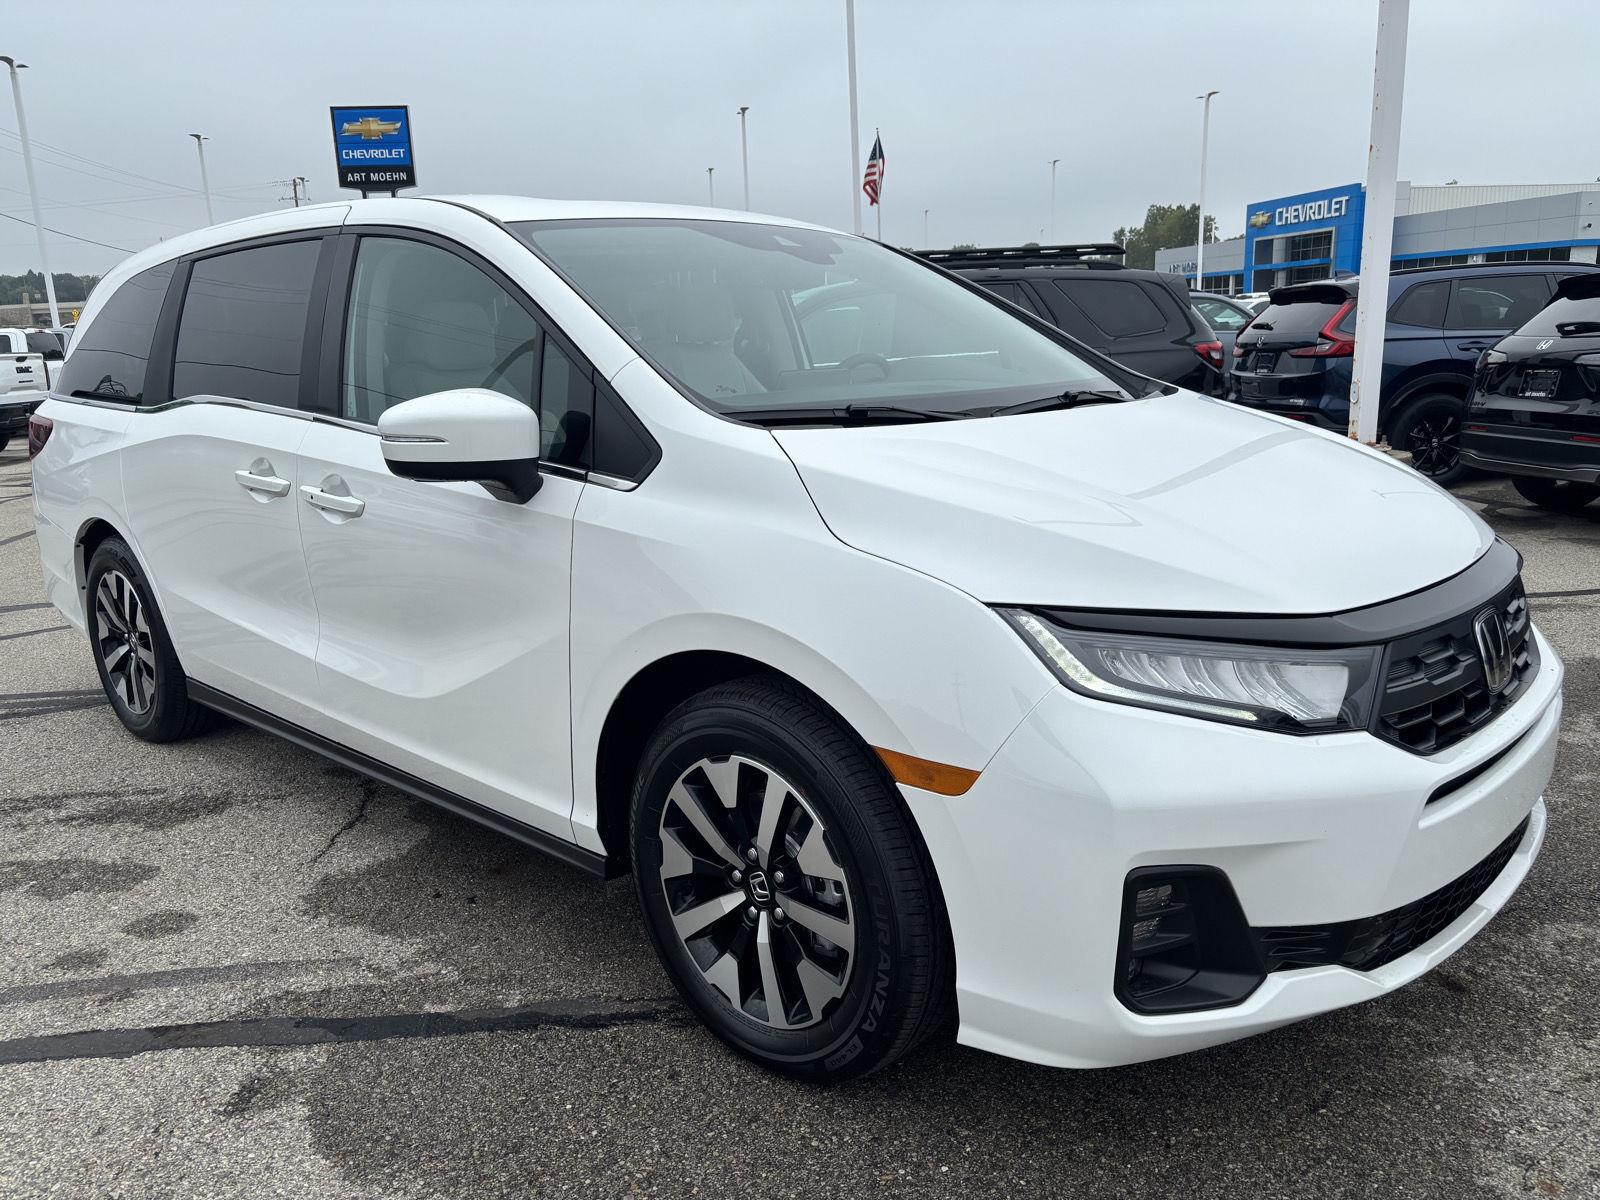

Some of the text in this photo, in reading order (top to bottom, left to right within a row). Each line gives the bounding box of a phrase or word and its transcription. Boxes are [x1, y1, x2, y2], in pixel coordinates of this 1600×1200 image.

[342, 149, 405, 159] CHEVROLET
[347, 172, 407, 182] ART MOEHN
[1275, 195, 1349, 226] CHEVROLET
[15, 366, 33, 374] GMC
